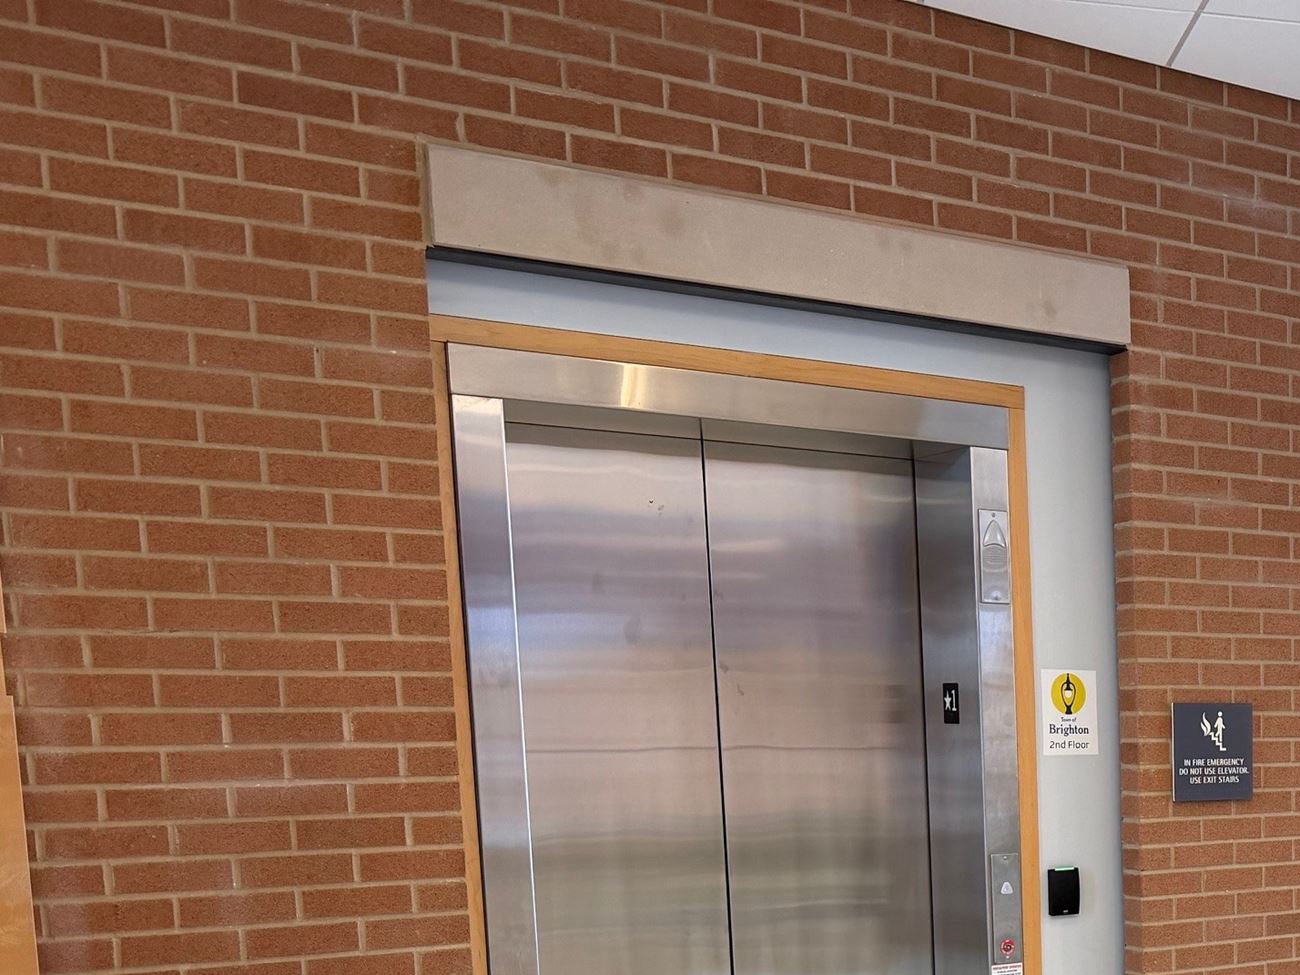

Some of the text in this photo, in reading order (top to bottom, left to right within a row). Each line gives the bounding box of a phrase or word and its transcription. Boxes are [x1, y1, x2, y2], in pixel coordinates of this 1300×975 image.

[1049, 724, 1089, 737] Brighton
[1049, 740, 1090, 749] 2nd Floor
[1184, 757, 1244, 766] IN FIRE EMERGENCY
[1179, 768, 1189, 776] DO
[1190, 767, 1202, 775] NOT
[1204, 767, 1216, 775] USE
[1189, 775, 1240, 784] USE EXIT STAIRS
